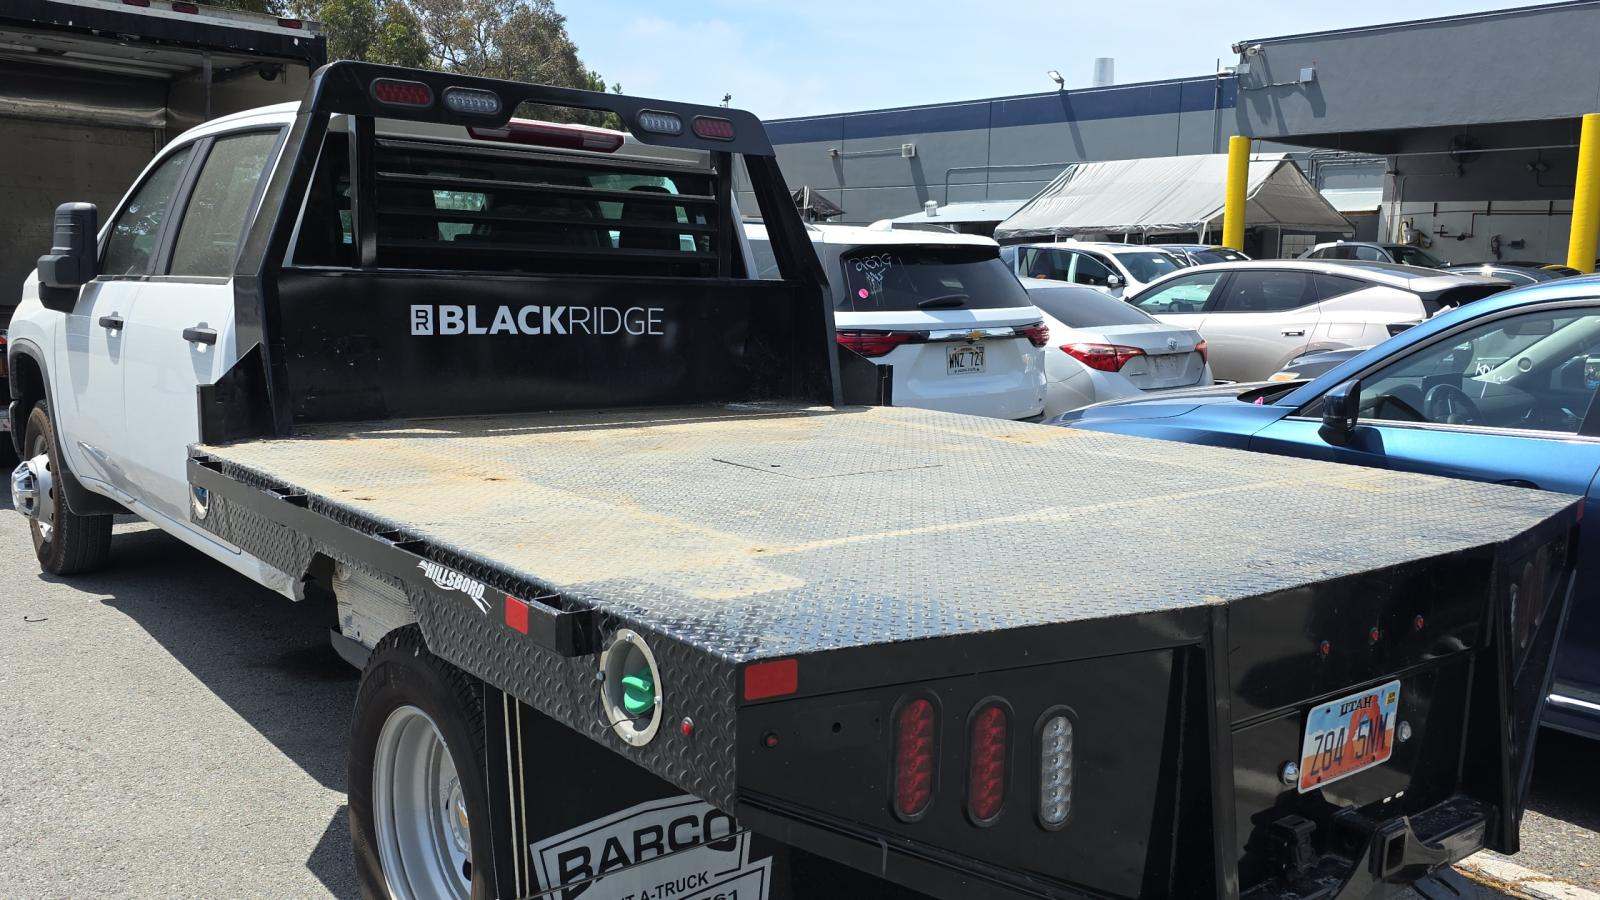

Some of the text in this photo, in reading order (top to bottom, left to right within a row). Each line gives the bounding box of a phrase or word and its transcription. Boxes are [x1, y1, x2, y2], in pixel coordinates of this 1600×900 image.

[438, 305, 664, 335] BLACKRIDGE
[425, 562, 485, 599] HILLSBORO
[1339, 695, 1372, 716] UTAH
[557, 808, 738, 900] BARCO
